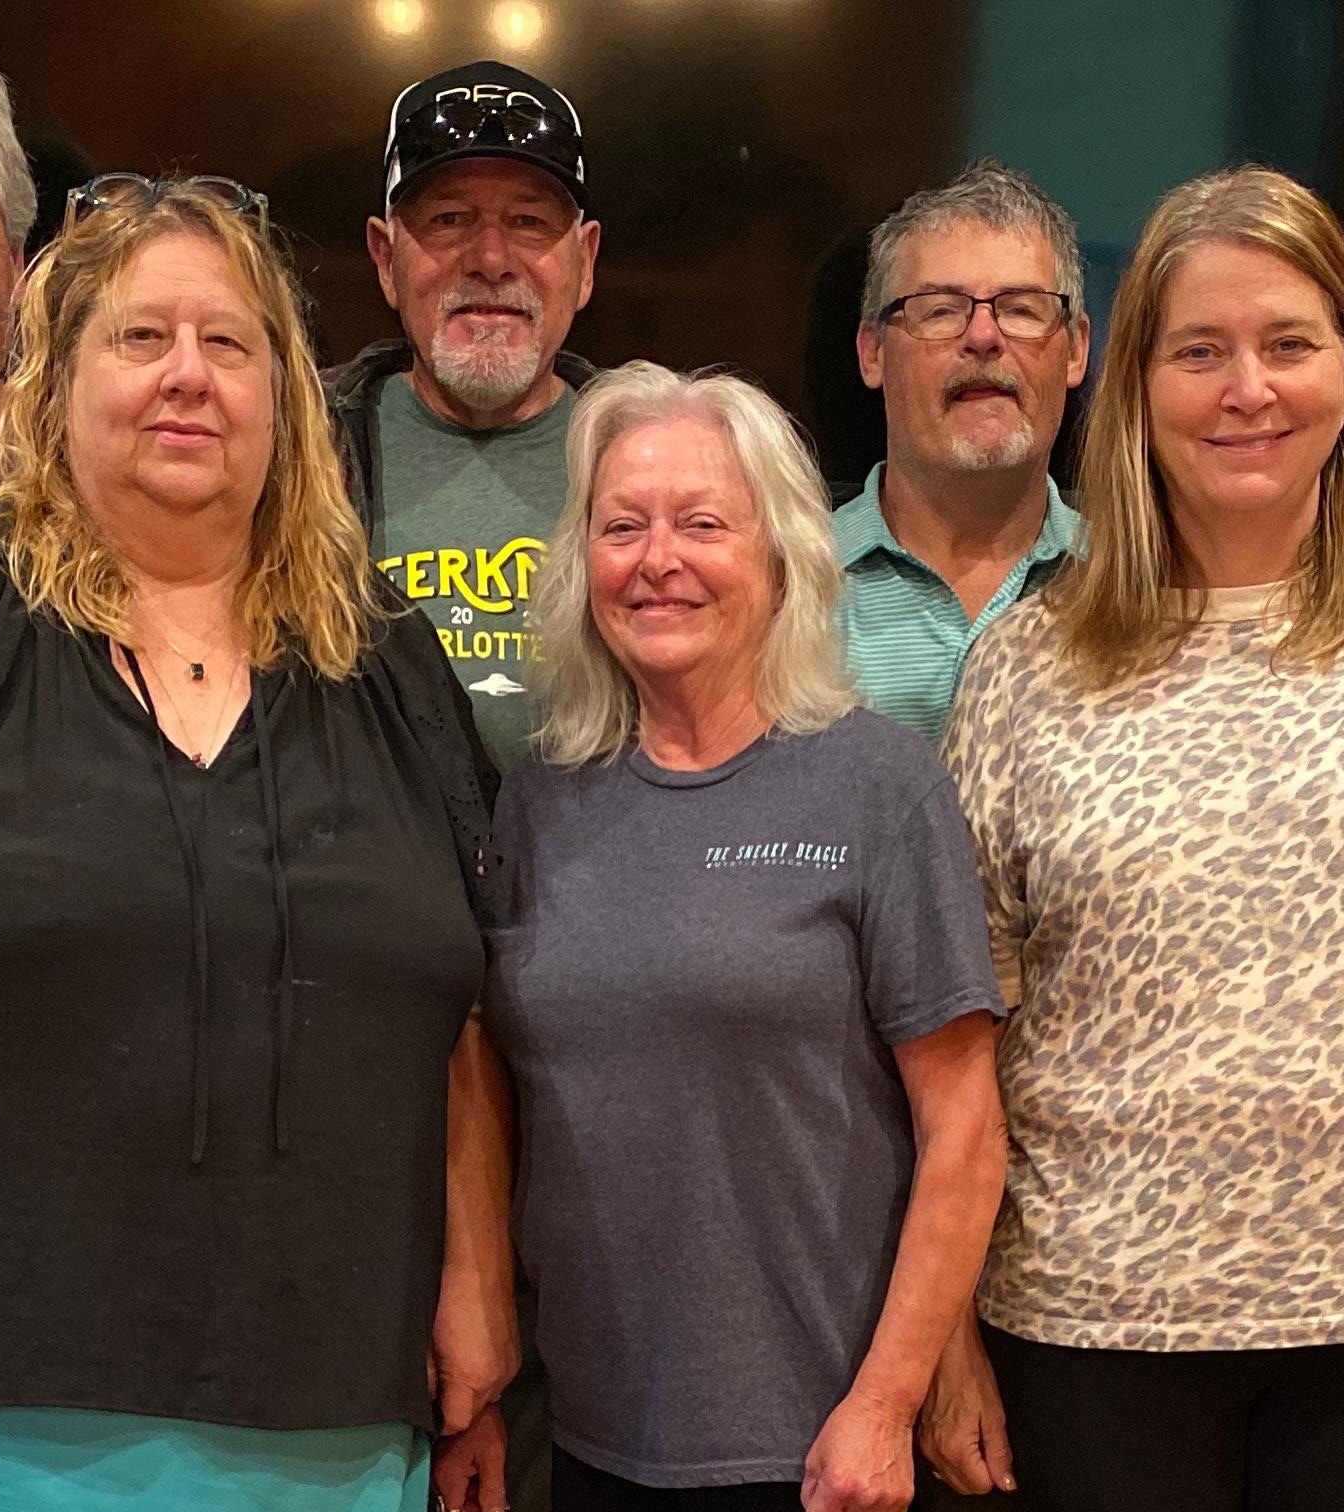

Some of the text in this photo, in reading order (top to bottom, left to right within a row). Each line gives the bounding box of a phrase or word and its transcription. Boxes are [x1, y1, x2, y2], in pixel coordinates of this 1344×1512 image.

[451, 606, 473, 624] 20
[705, 842, 848, 863] THE SNEAKY BEAGLE
